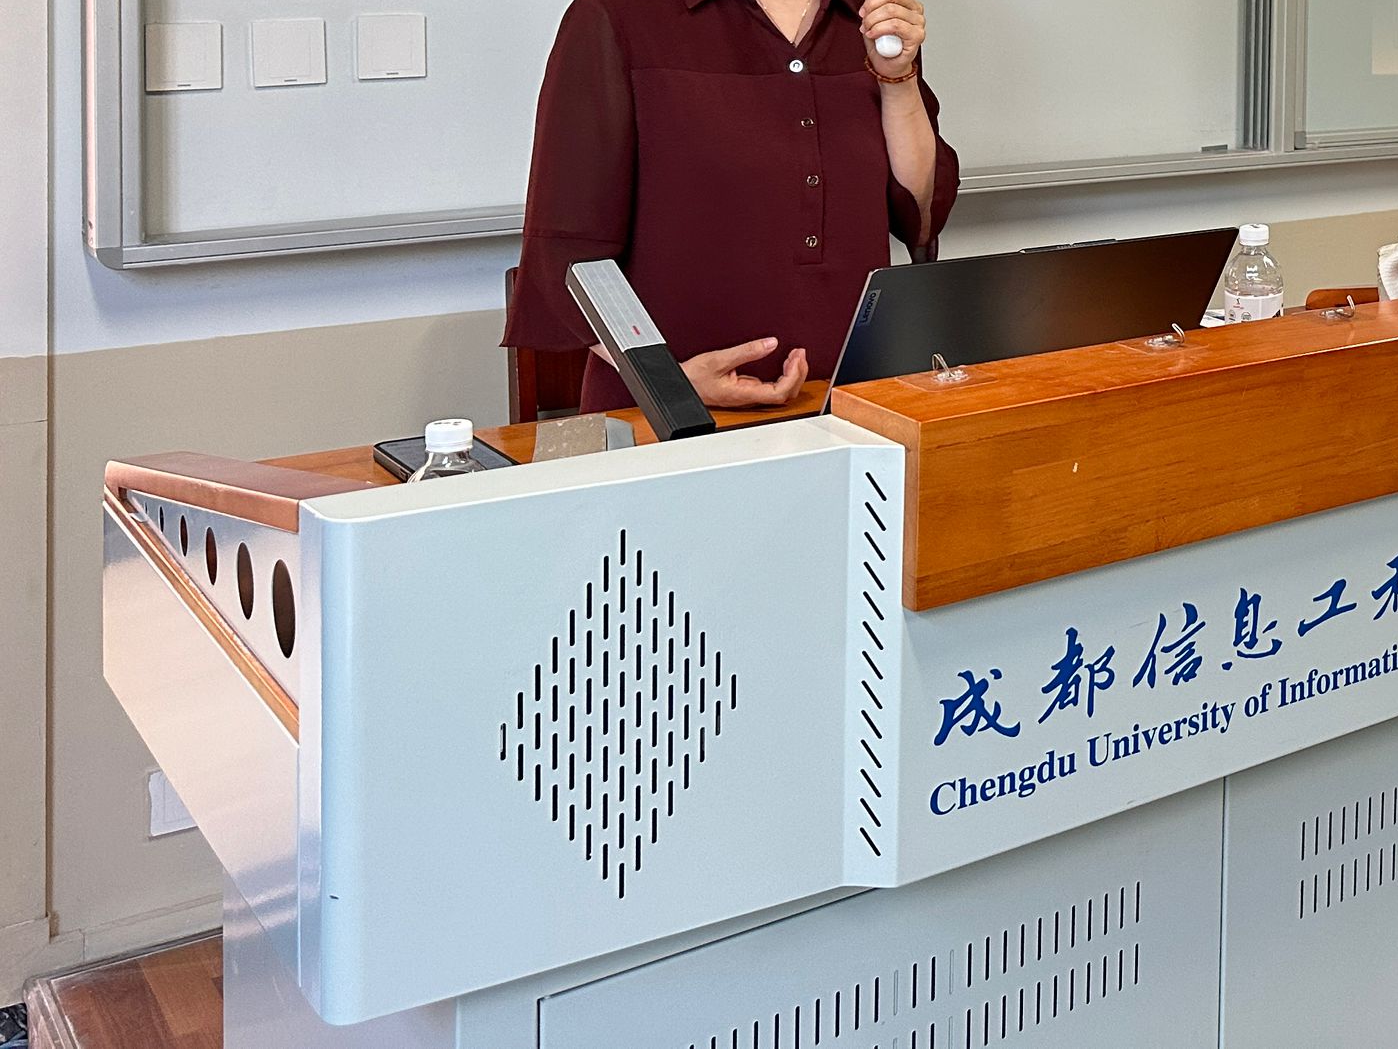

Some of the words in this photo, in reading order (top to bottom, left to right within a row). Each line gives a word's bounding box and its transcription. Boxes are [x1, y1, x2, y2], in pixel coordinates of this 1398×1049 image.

[859, 292, 877, 323] Lenovo
[929, 750, 1077, 816] Chengdu
[1087, 699, 1235, 767] University
[1244, 683, 1273, 718] of
